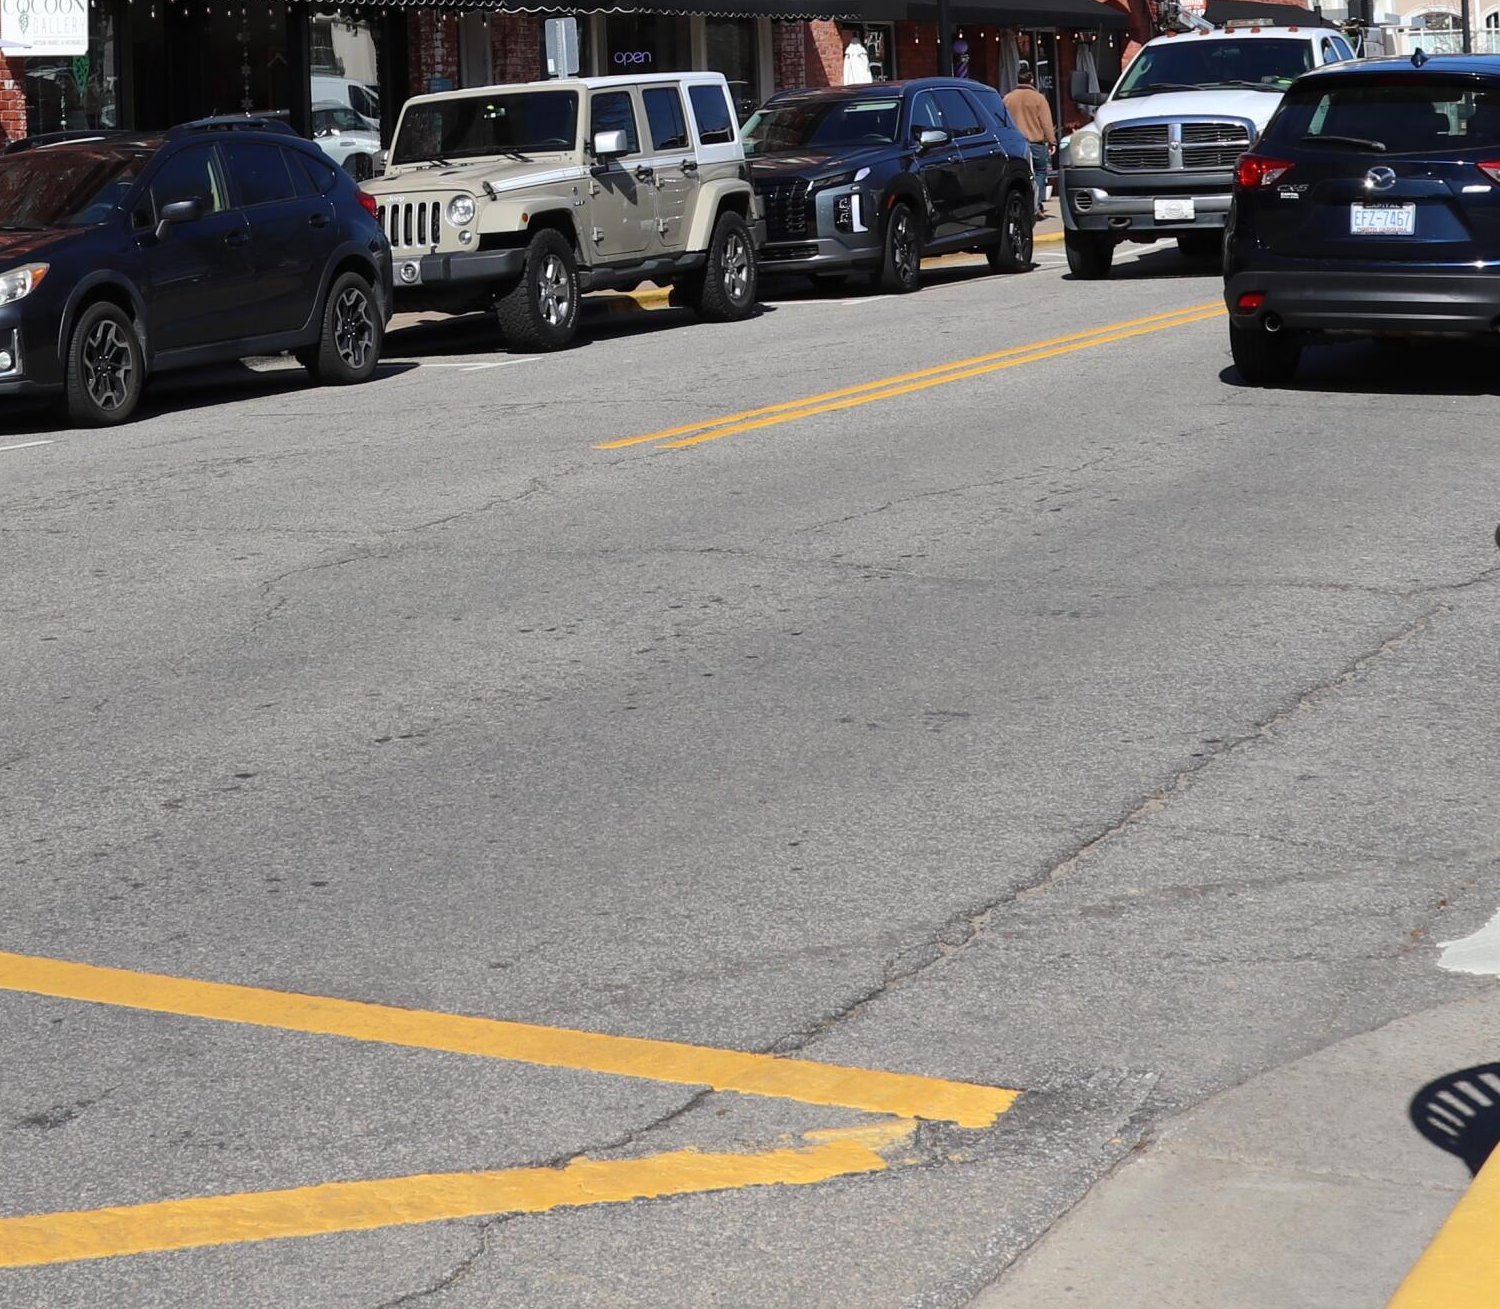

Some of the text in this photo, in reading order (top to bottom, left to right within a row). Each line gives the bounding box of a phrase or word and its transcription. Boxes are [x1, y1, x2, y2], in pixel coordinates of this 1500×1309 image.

[33, 17, 86, 34] GALLERY
[614, 51, 652, 66] open
[1277, 183, 1309, 192] CX-5
[386, 195, 405, 203] Jeep
[1354, 210, 1411, 226] EFZ-7467
